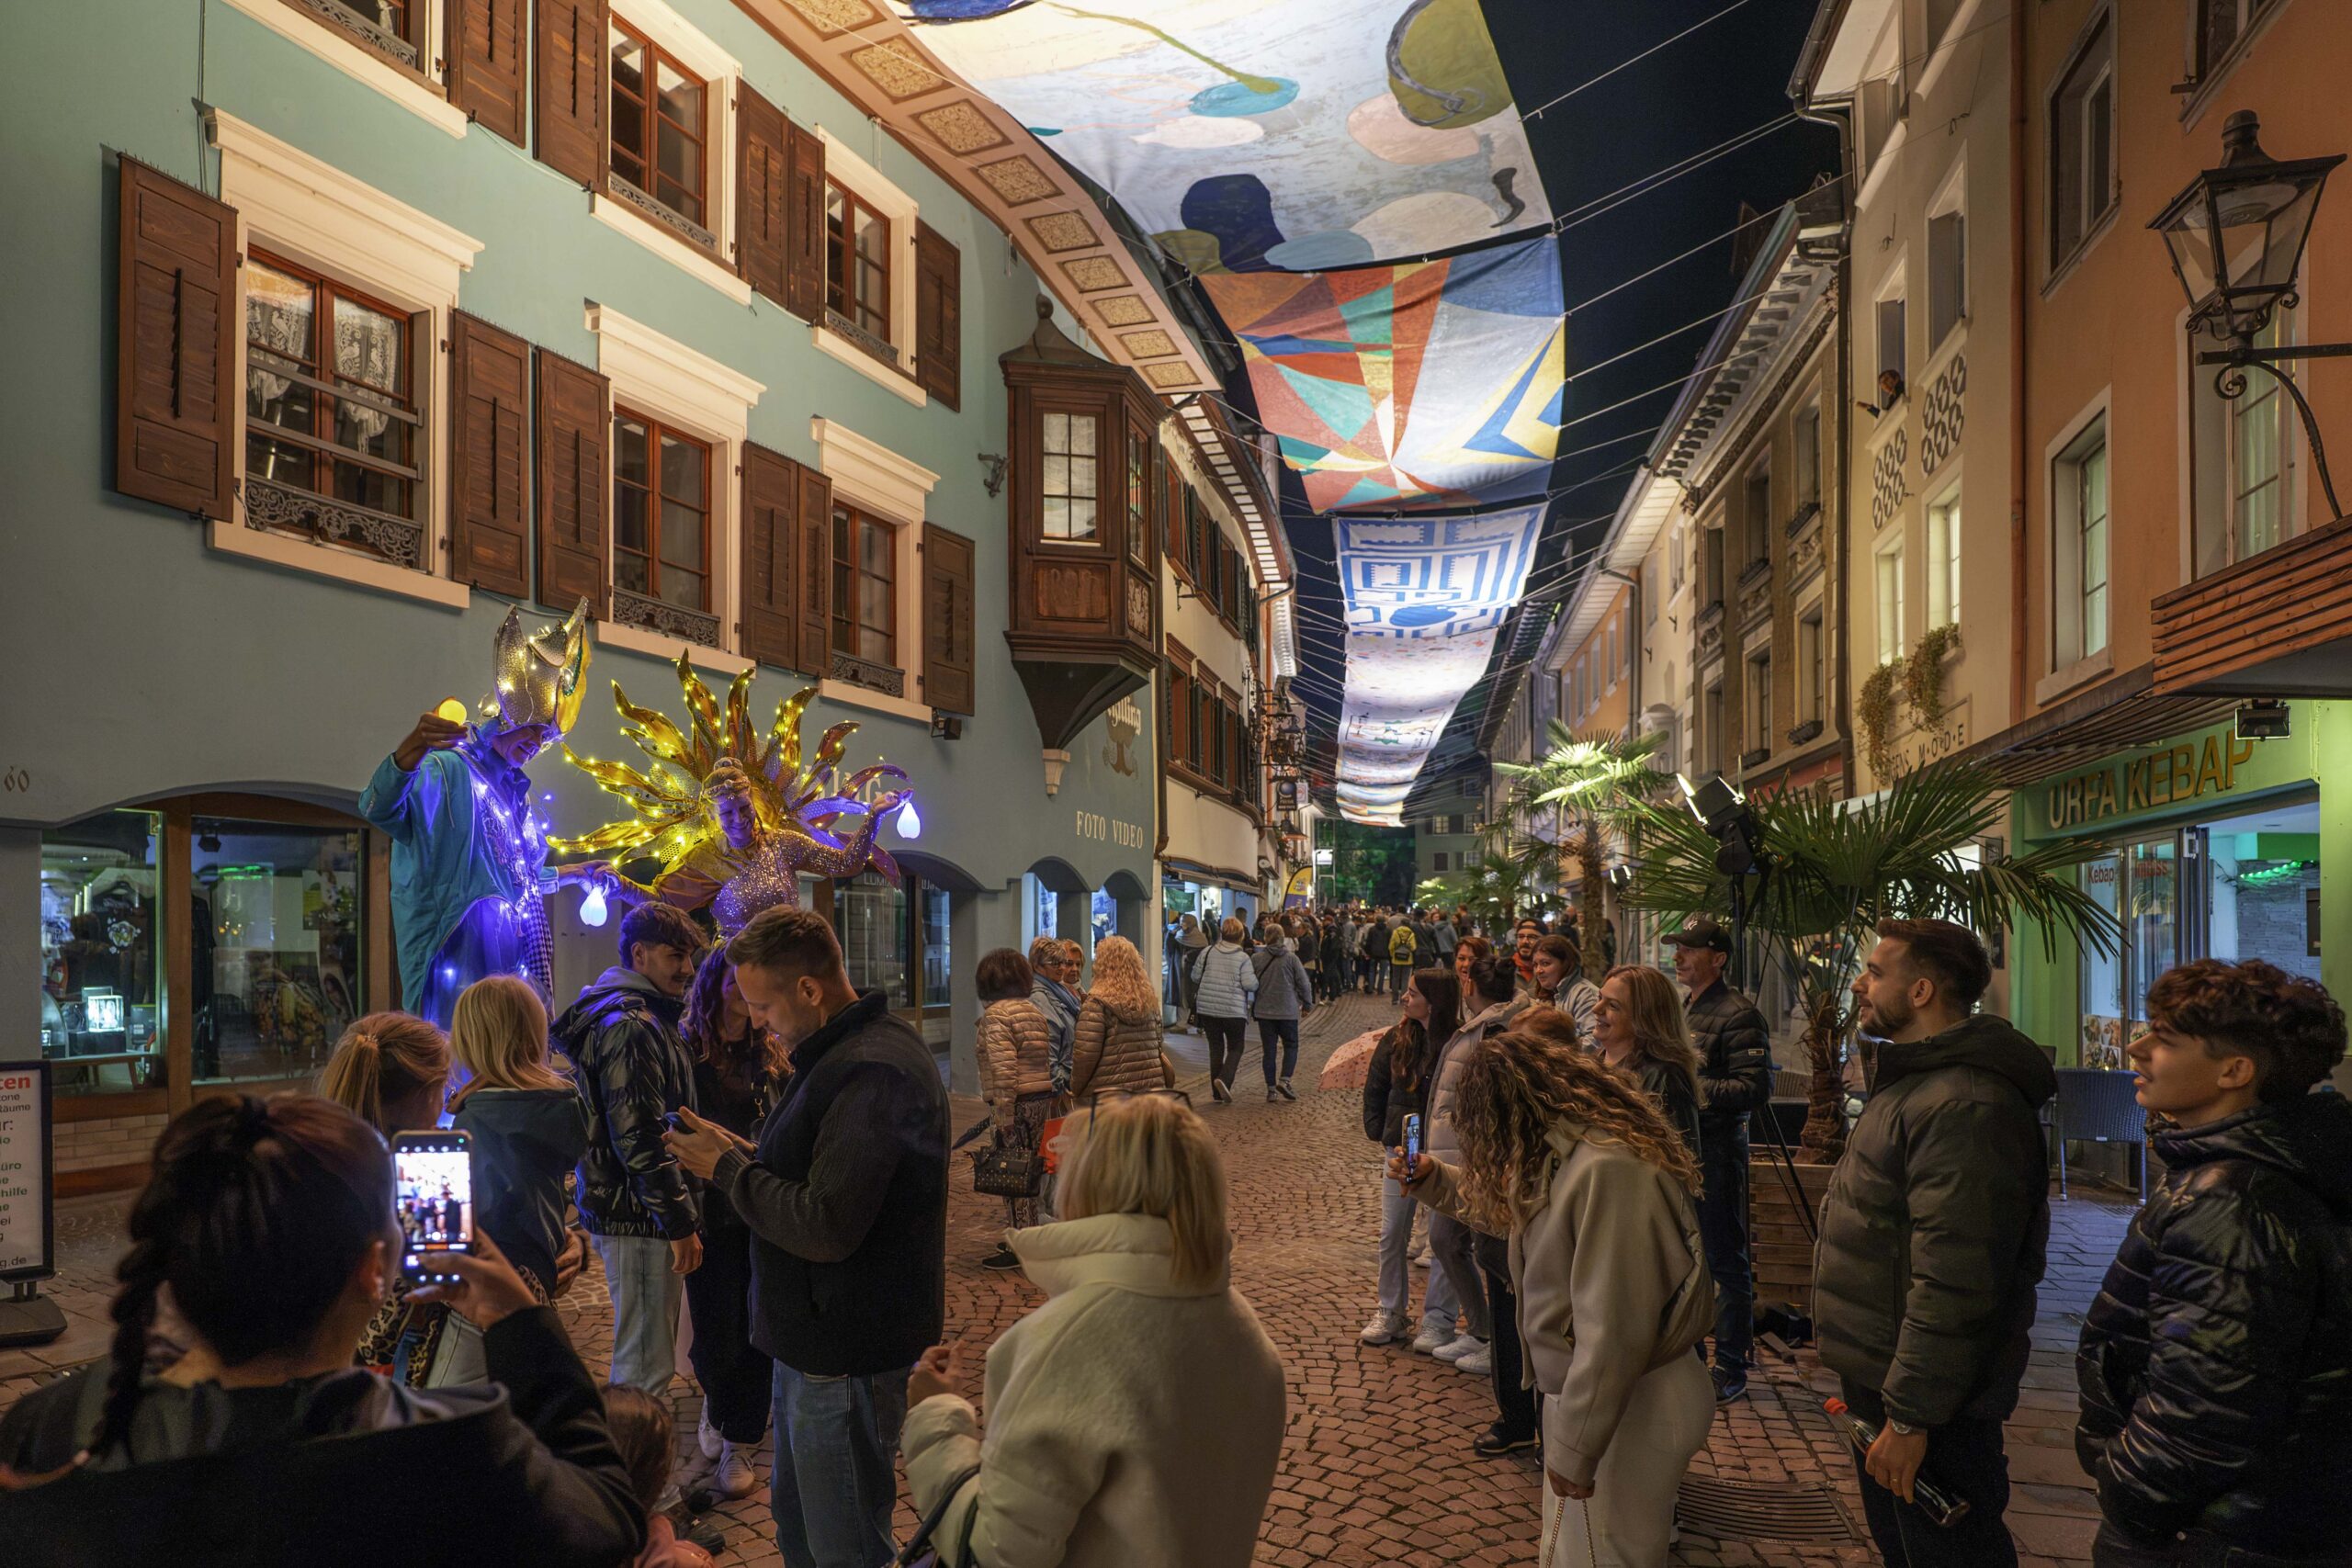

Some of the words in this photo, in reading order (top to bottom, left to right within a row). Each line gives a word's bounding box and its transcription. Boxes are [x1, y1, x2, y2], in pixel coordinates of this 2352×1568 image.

[4, 765, 29, 793] 60
[2049, 769, 2118, 829] URFA
[2126, 729, 2254, 811] KEBAP
[1076, 811, 1106, 841] FOTO
[1113, 819, 1143, 850] VIDEO
[2087, 864, 2115, 886] Kebap
[0, 1162, 22, 1171] üro
[0, 1186, 28, 1198] hilfe
